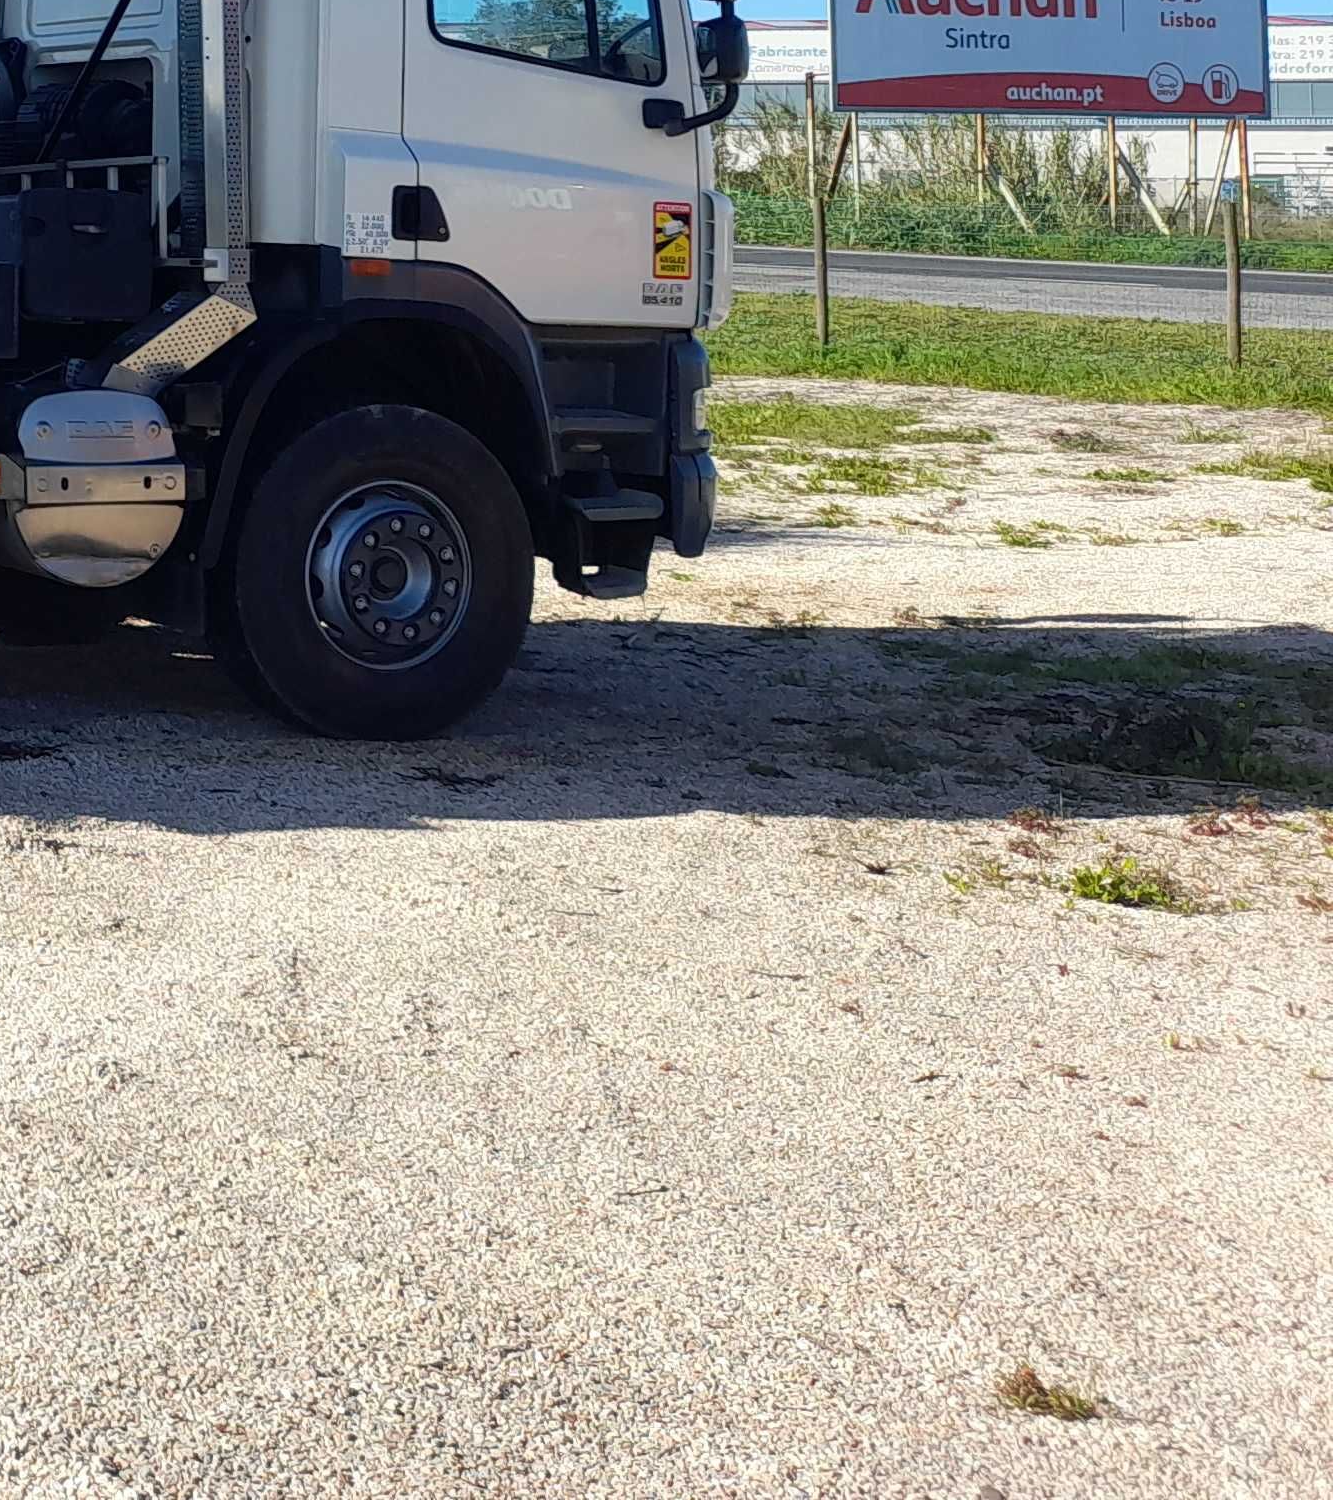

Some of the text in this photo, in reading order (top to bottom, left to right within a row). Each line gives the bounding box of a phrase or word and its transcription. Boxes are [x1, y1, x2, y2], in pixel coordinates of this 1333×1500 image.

[1160, 11, 1216, 29] Lisboa
[945, 27, 1011, 50] Sintra
[1299, 35, 1324, 46] 219
[1299, 49, 1325, 60] 219
[1006, 82, 1105, 106] auchan.pt
